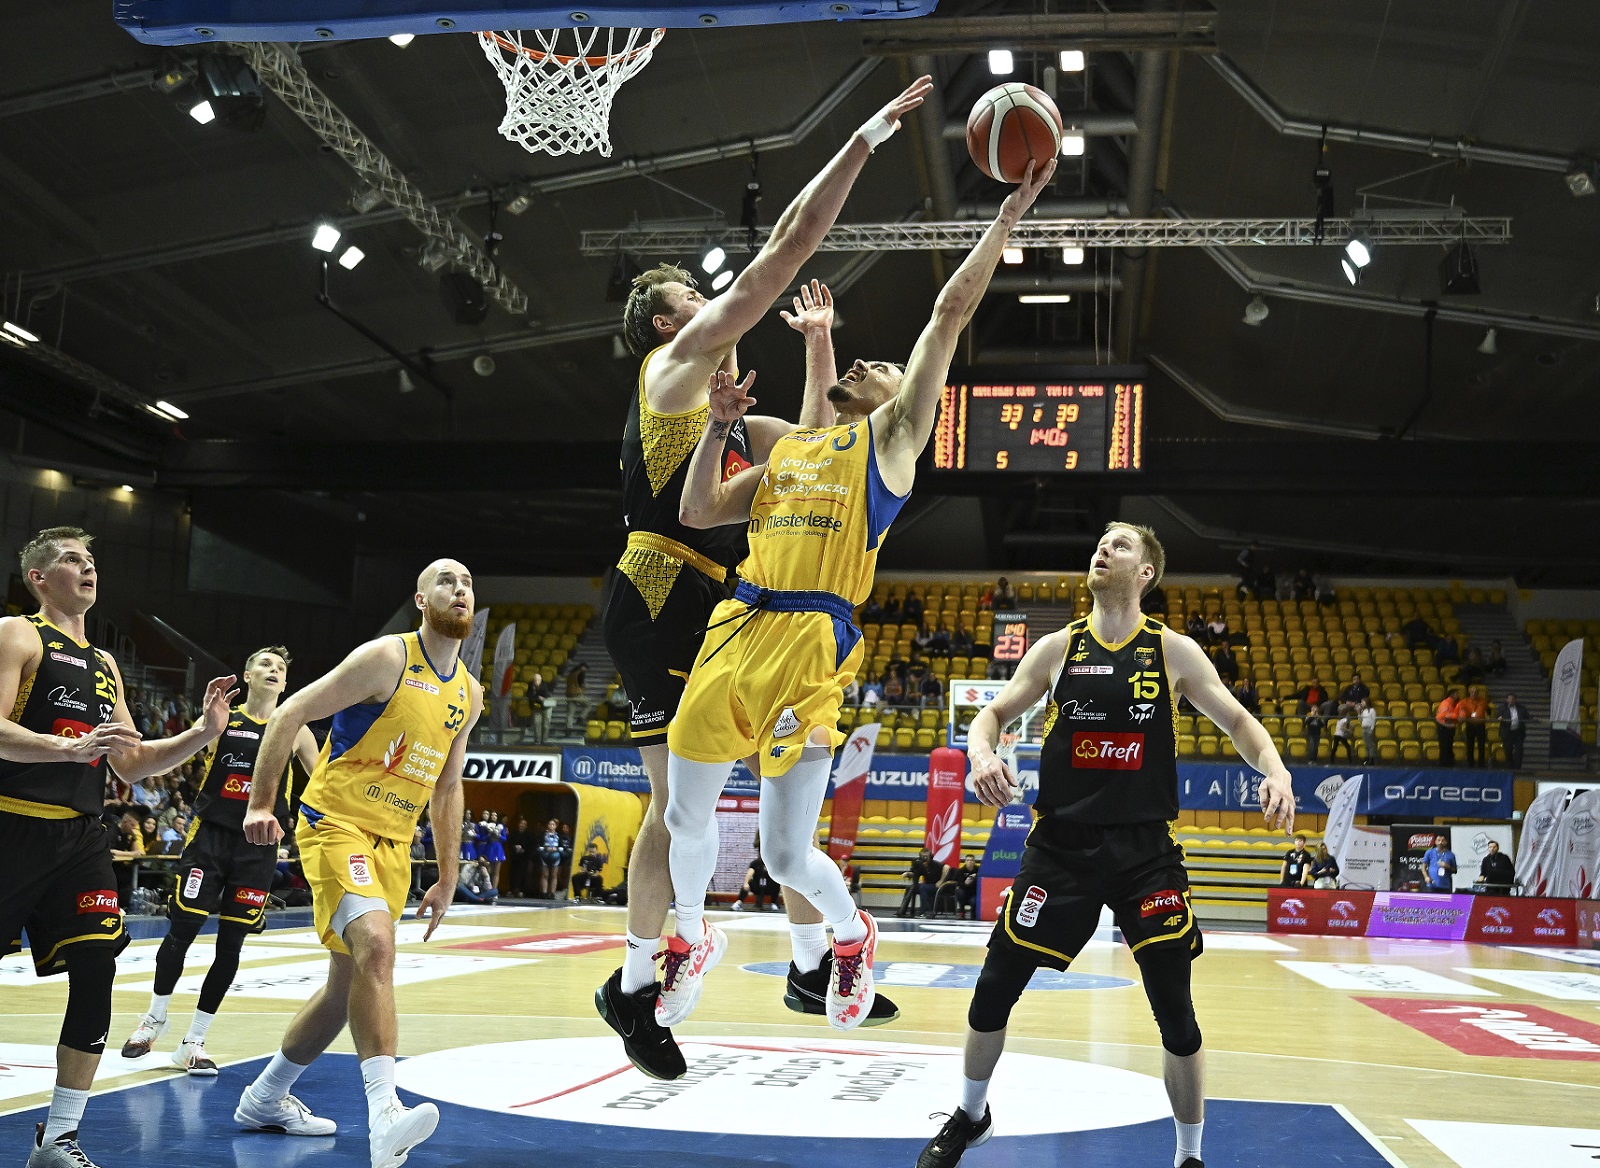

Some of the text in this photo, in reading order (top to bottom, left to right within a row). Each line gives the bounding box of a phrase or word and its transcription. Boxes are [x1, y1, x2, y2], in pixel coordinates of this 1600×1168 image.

[1001, 404, 1079, 422] 33 2 39
[779, 457, 833, 470] Krajowa
[996, 450, 1078, 469] 5 3
[777, 470, 818, 482] Grupa
[773, 482, 849, 496] Spożywcza
[766, 510, 842, 532] Masterlease
[1078, 639, 1085, 651] C
[1069, 652, 1089, 662] 4F
[1128, 671, 1160, 699] 15
[1100, 739, 1140, 762] Trefl
[408, 753, 436, 769] Grupa
[462, 758, 554, 779] DYNIA
[1384, 784, 1502, 803] asseco
[992, 850, 1018, 860] plus
[96, 896, 118, 908] Trefl
[247, 891, 265, 903] Trefl
[1153, 894, 1180, 907] Trefl
[100, 917, 118, 928] 4F
[1163, 915, 1183, 927] 4F
